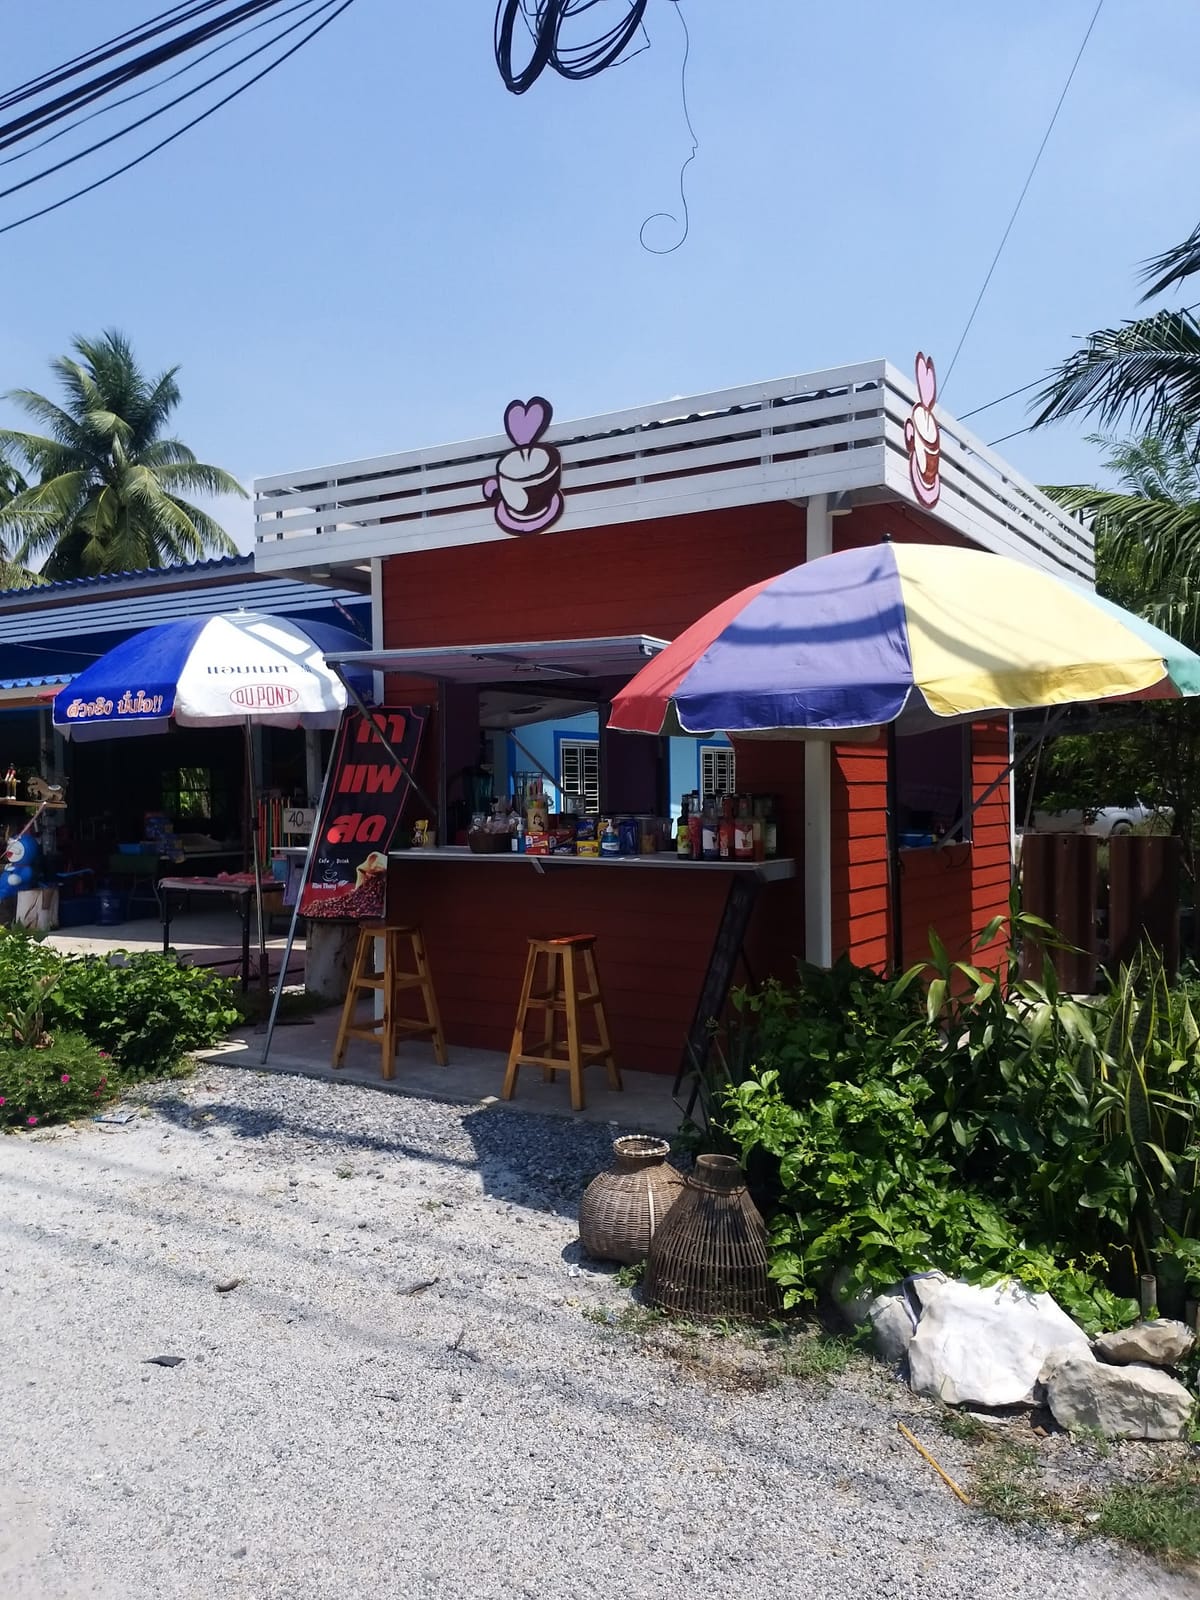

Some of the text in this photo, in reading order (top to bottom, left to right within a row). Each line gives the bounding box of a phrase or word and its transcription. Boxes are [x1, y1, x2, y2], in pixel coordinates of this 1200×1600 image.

[66, 697, 114, 718] ตัวจริง
[288, 810, 304, 827] 40
[327, 812, 387, 844] สด
